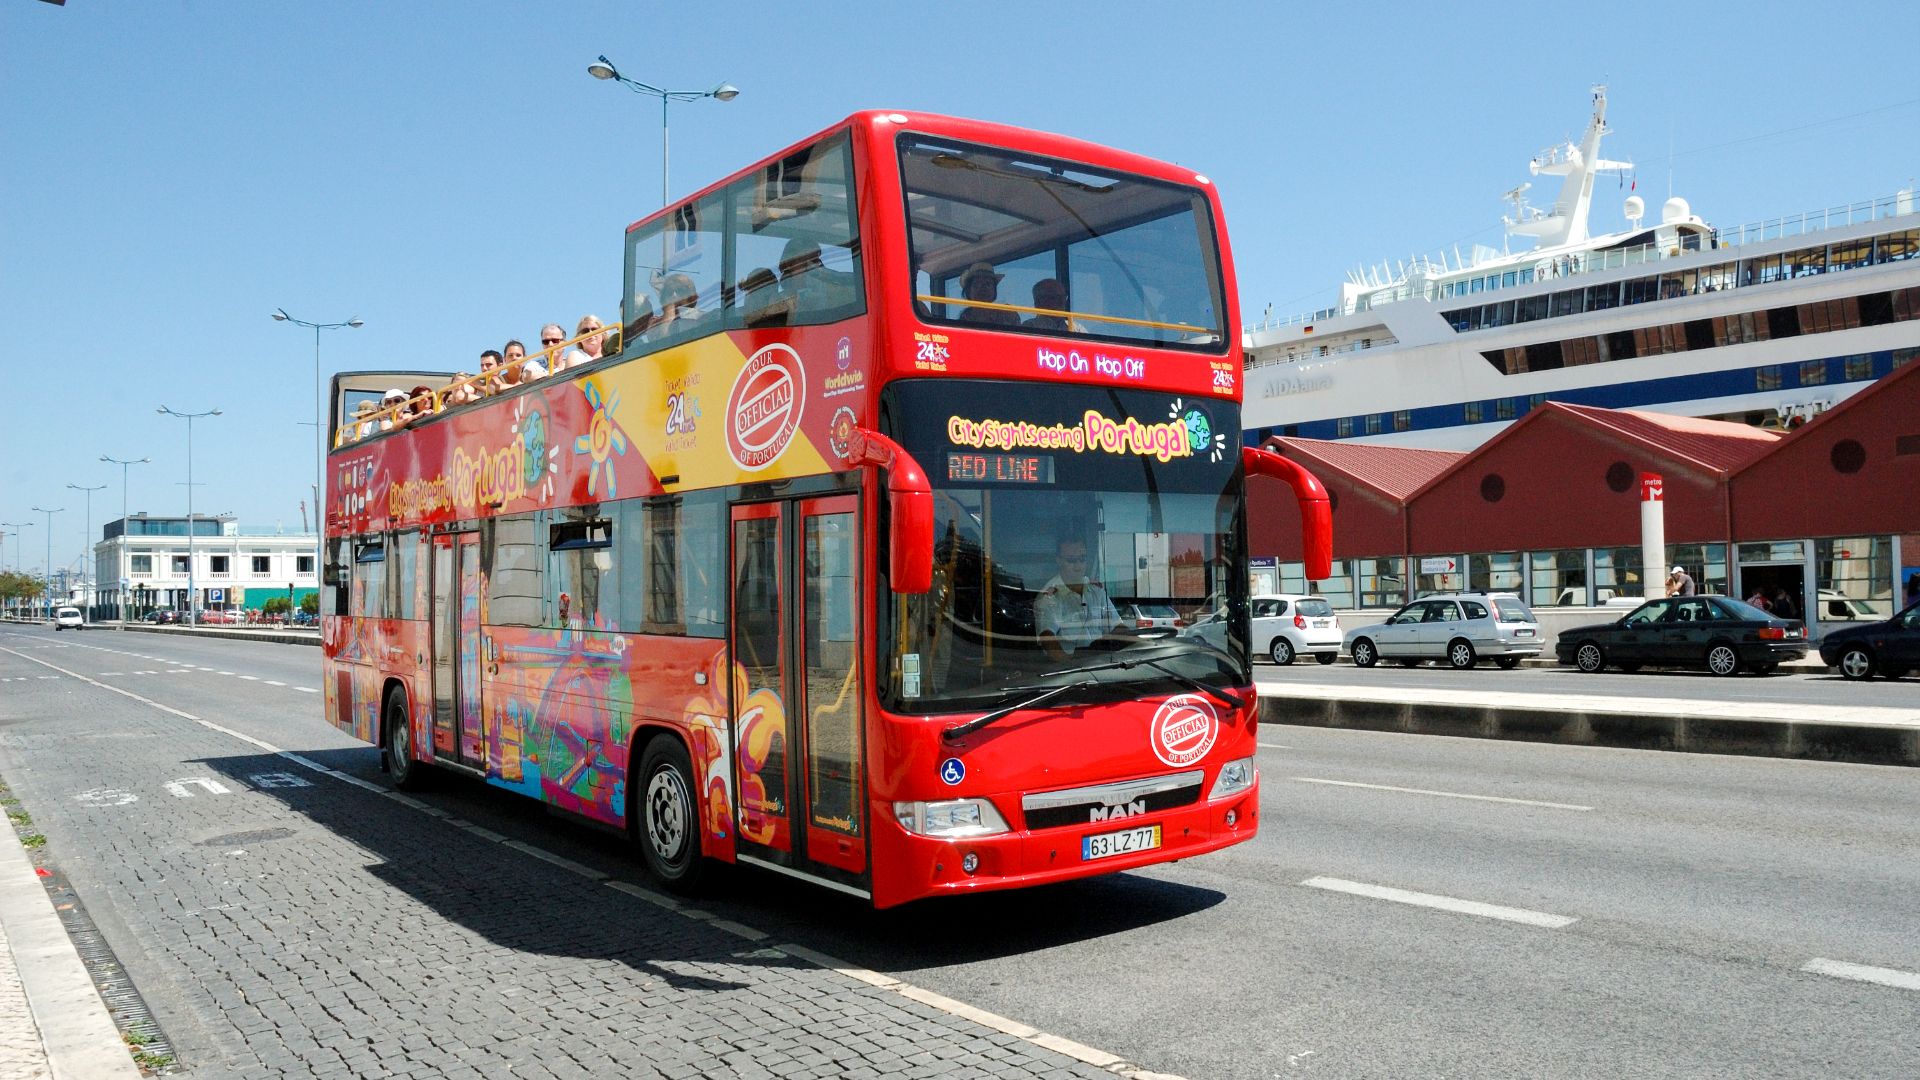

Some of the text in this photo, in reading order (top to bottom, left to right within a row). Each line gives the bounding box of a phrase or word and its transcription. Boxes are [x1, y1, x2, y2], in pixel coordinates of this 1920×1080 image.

[746, 351, 774, 379] TOUR
[917, 342, 934, 360] 24
[1037, 348, 1144, 378] Hop On Hop Off
[1213, 369, 1225, 385] 24
[666, 391, 685, 435] 24
[738, 382, 791, 432] OFFICIAL
[740, 449, 752, 464] OF
[752, 420, 795, 465] PORTUGAL
[1084, 410, 1190, 462] Portugal
[452, 432, 525, 514] Portugal
[948, 455, 1039, 482] RED LINE
[1166, 698, 1189, 712] TOUR
[1164, 715, 1207, 744] OFFICIAL
[1169, 736, 1212, 763] OF PORTUGAL
[1089, 799, 1146, 824] MAN
